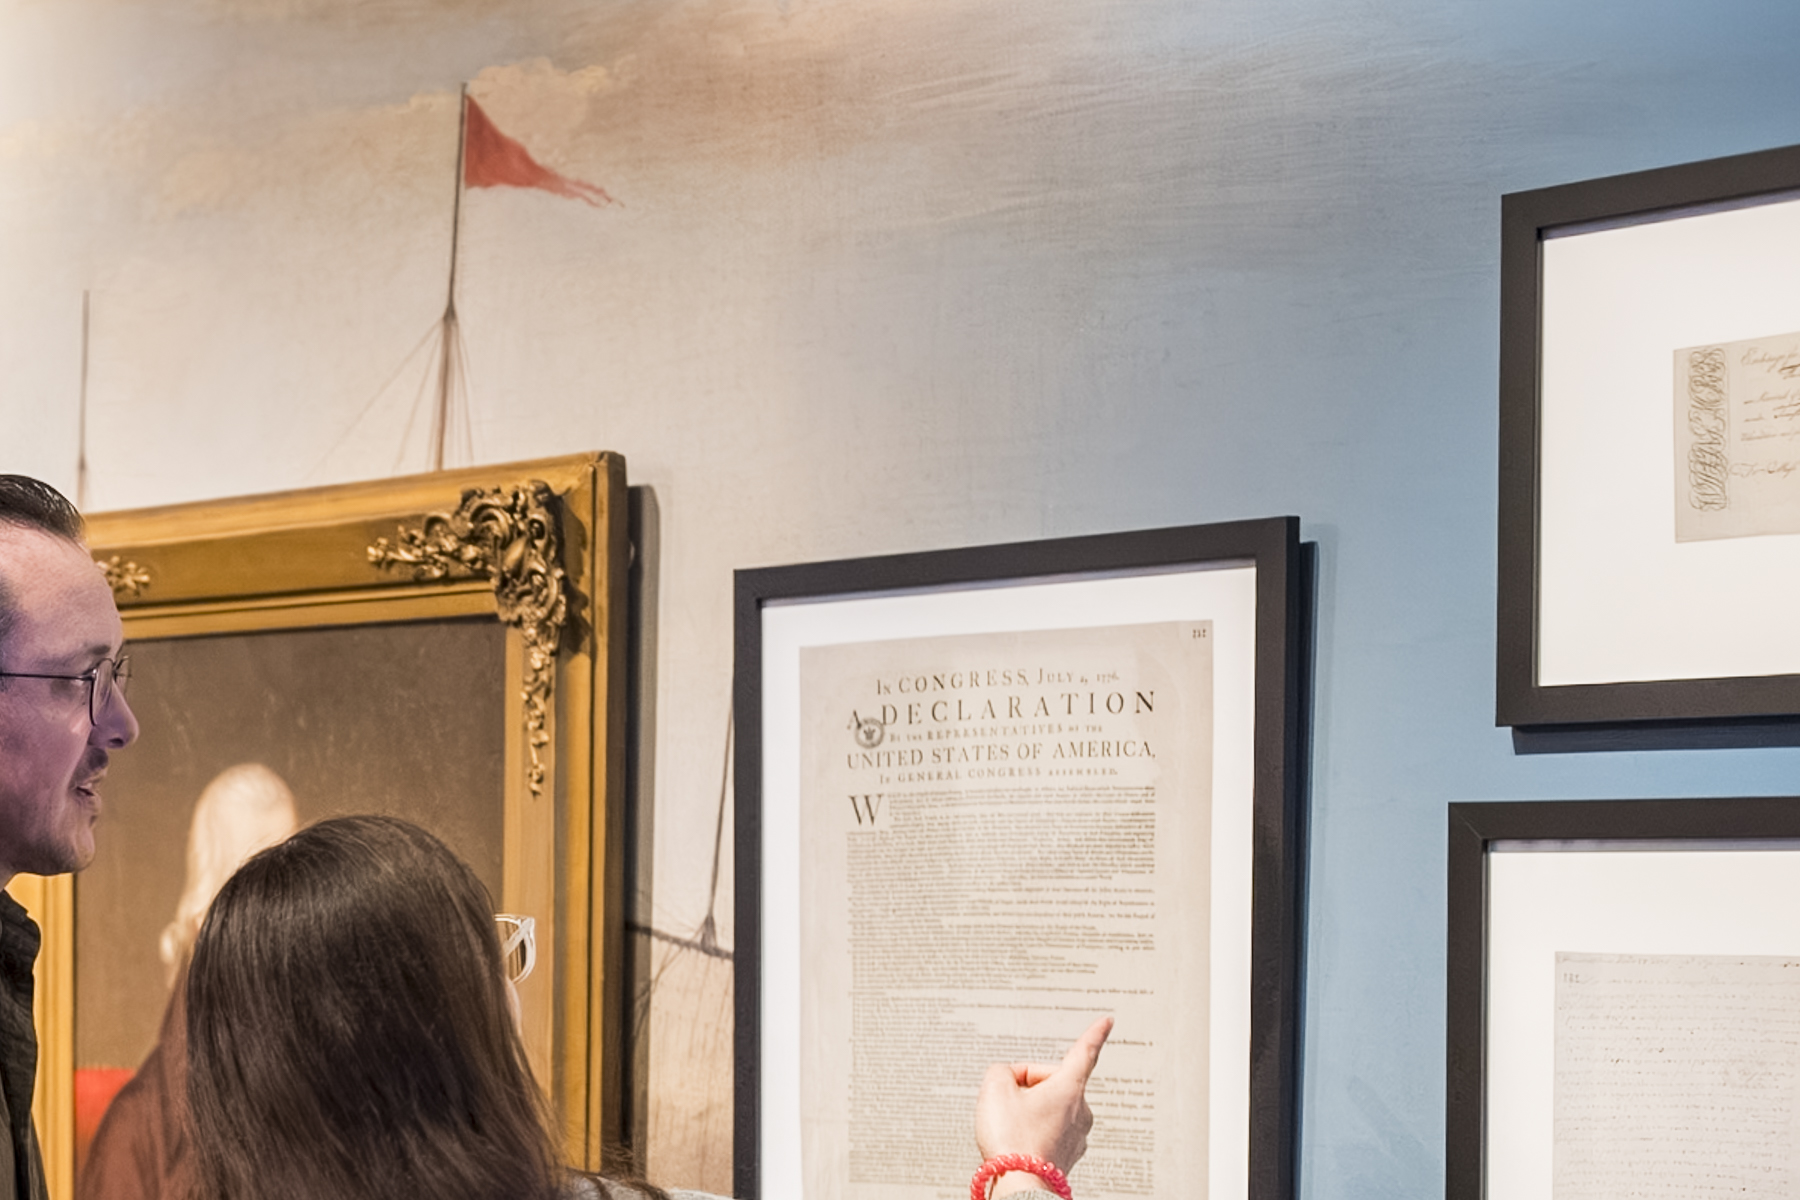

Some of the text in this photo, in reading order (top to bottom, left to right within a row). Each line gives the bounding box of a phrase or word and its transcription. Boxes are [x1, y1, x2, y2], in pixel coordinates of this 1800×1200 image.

[898, 670, 1028, 692] CONGRESS,
[881, 690, 1155, 727] DECLARATION
[847, 740, 1155, 768] UNITED STATES OF AMERICA,
